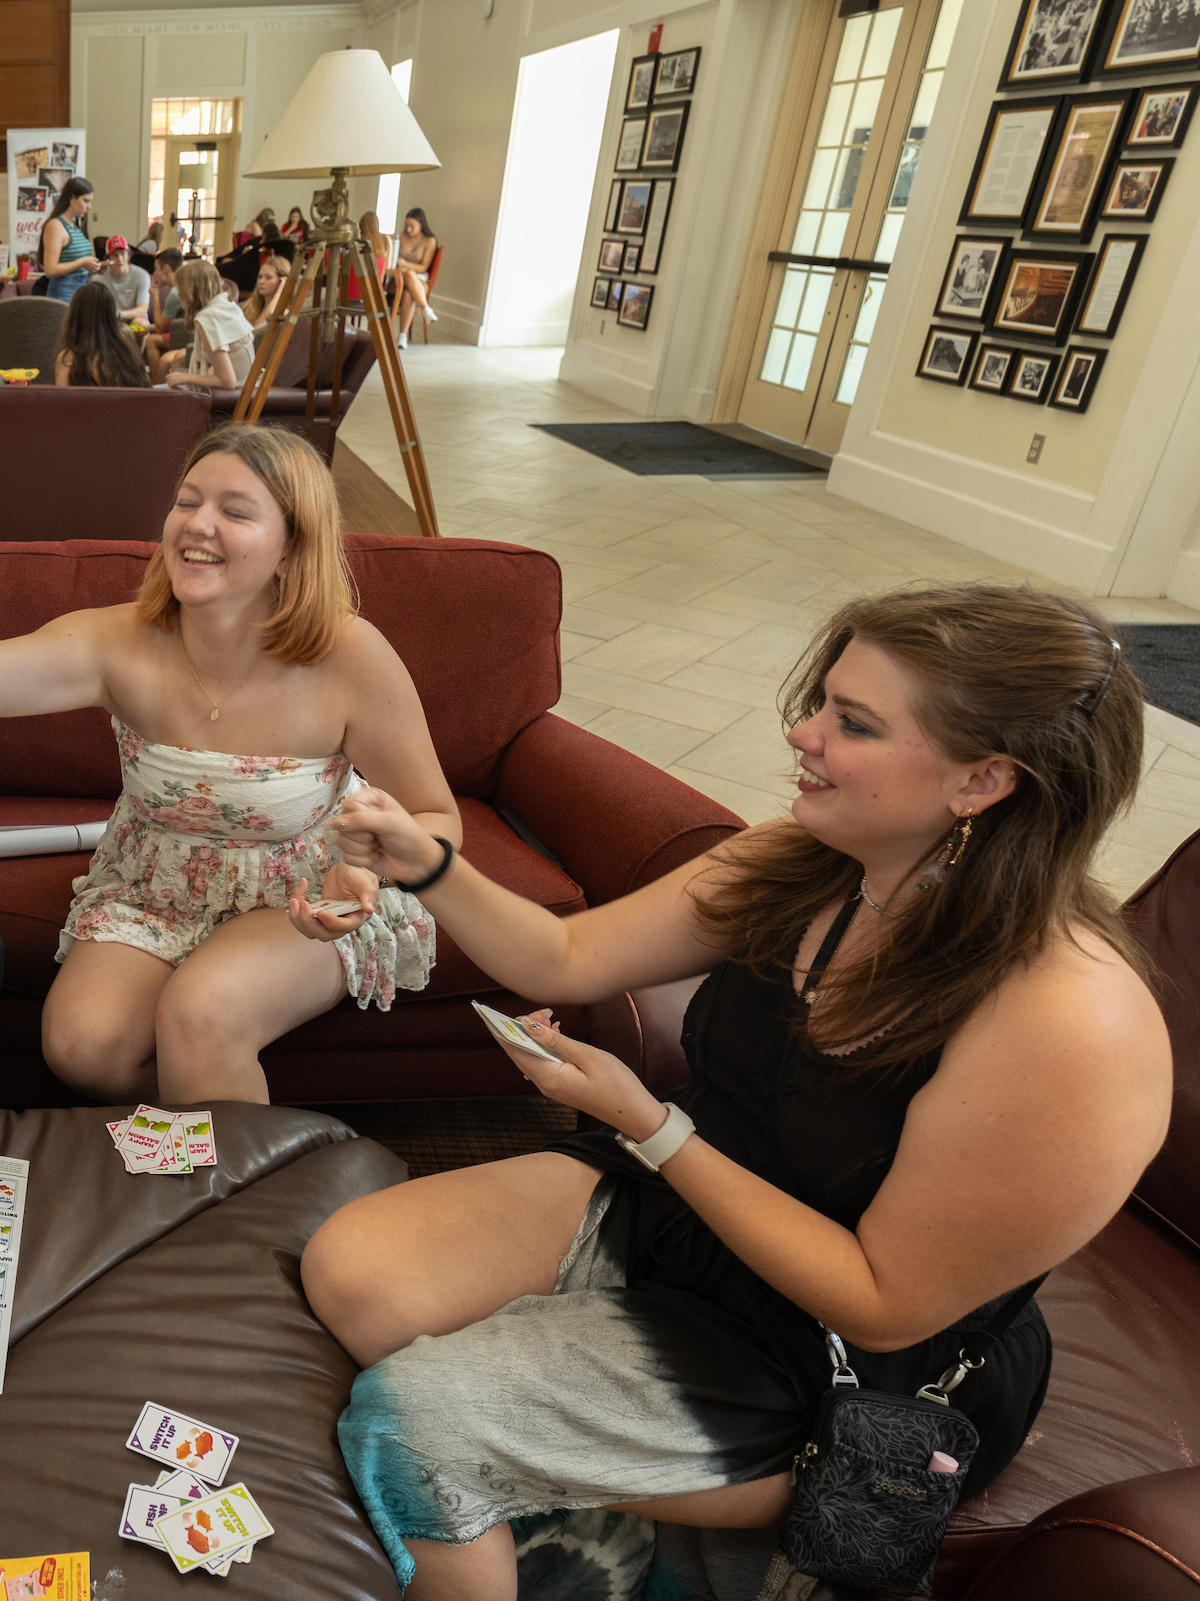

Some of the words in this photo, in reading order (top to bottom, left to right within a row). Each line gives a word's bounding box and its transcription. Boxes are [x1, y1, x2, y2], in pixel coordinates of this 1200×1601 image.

[128, 1132, 160, 1144] SALMON
[129, 1137, 154, 1148] HAPPY
[150, 1416, 171, 1451] SWITCH
[161, 1438, 171, 1449] IT
[168, 1424, 177, 1437] UP
[145, 1504, 158, 1527] FISH
[215, 1507, 228, 1519] IT
[223, 1519, 236, 1534] UP
[221, 1498, 250, 1537] SWITCH
[57, 1566, 65, 1581] ONES.
